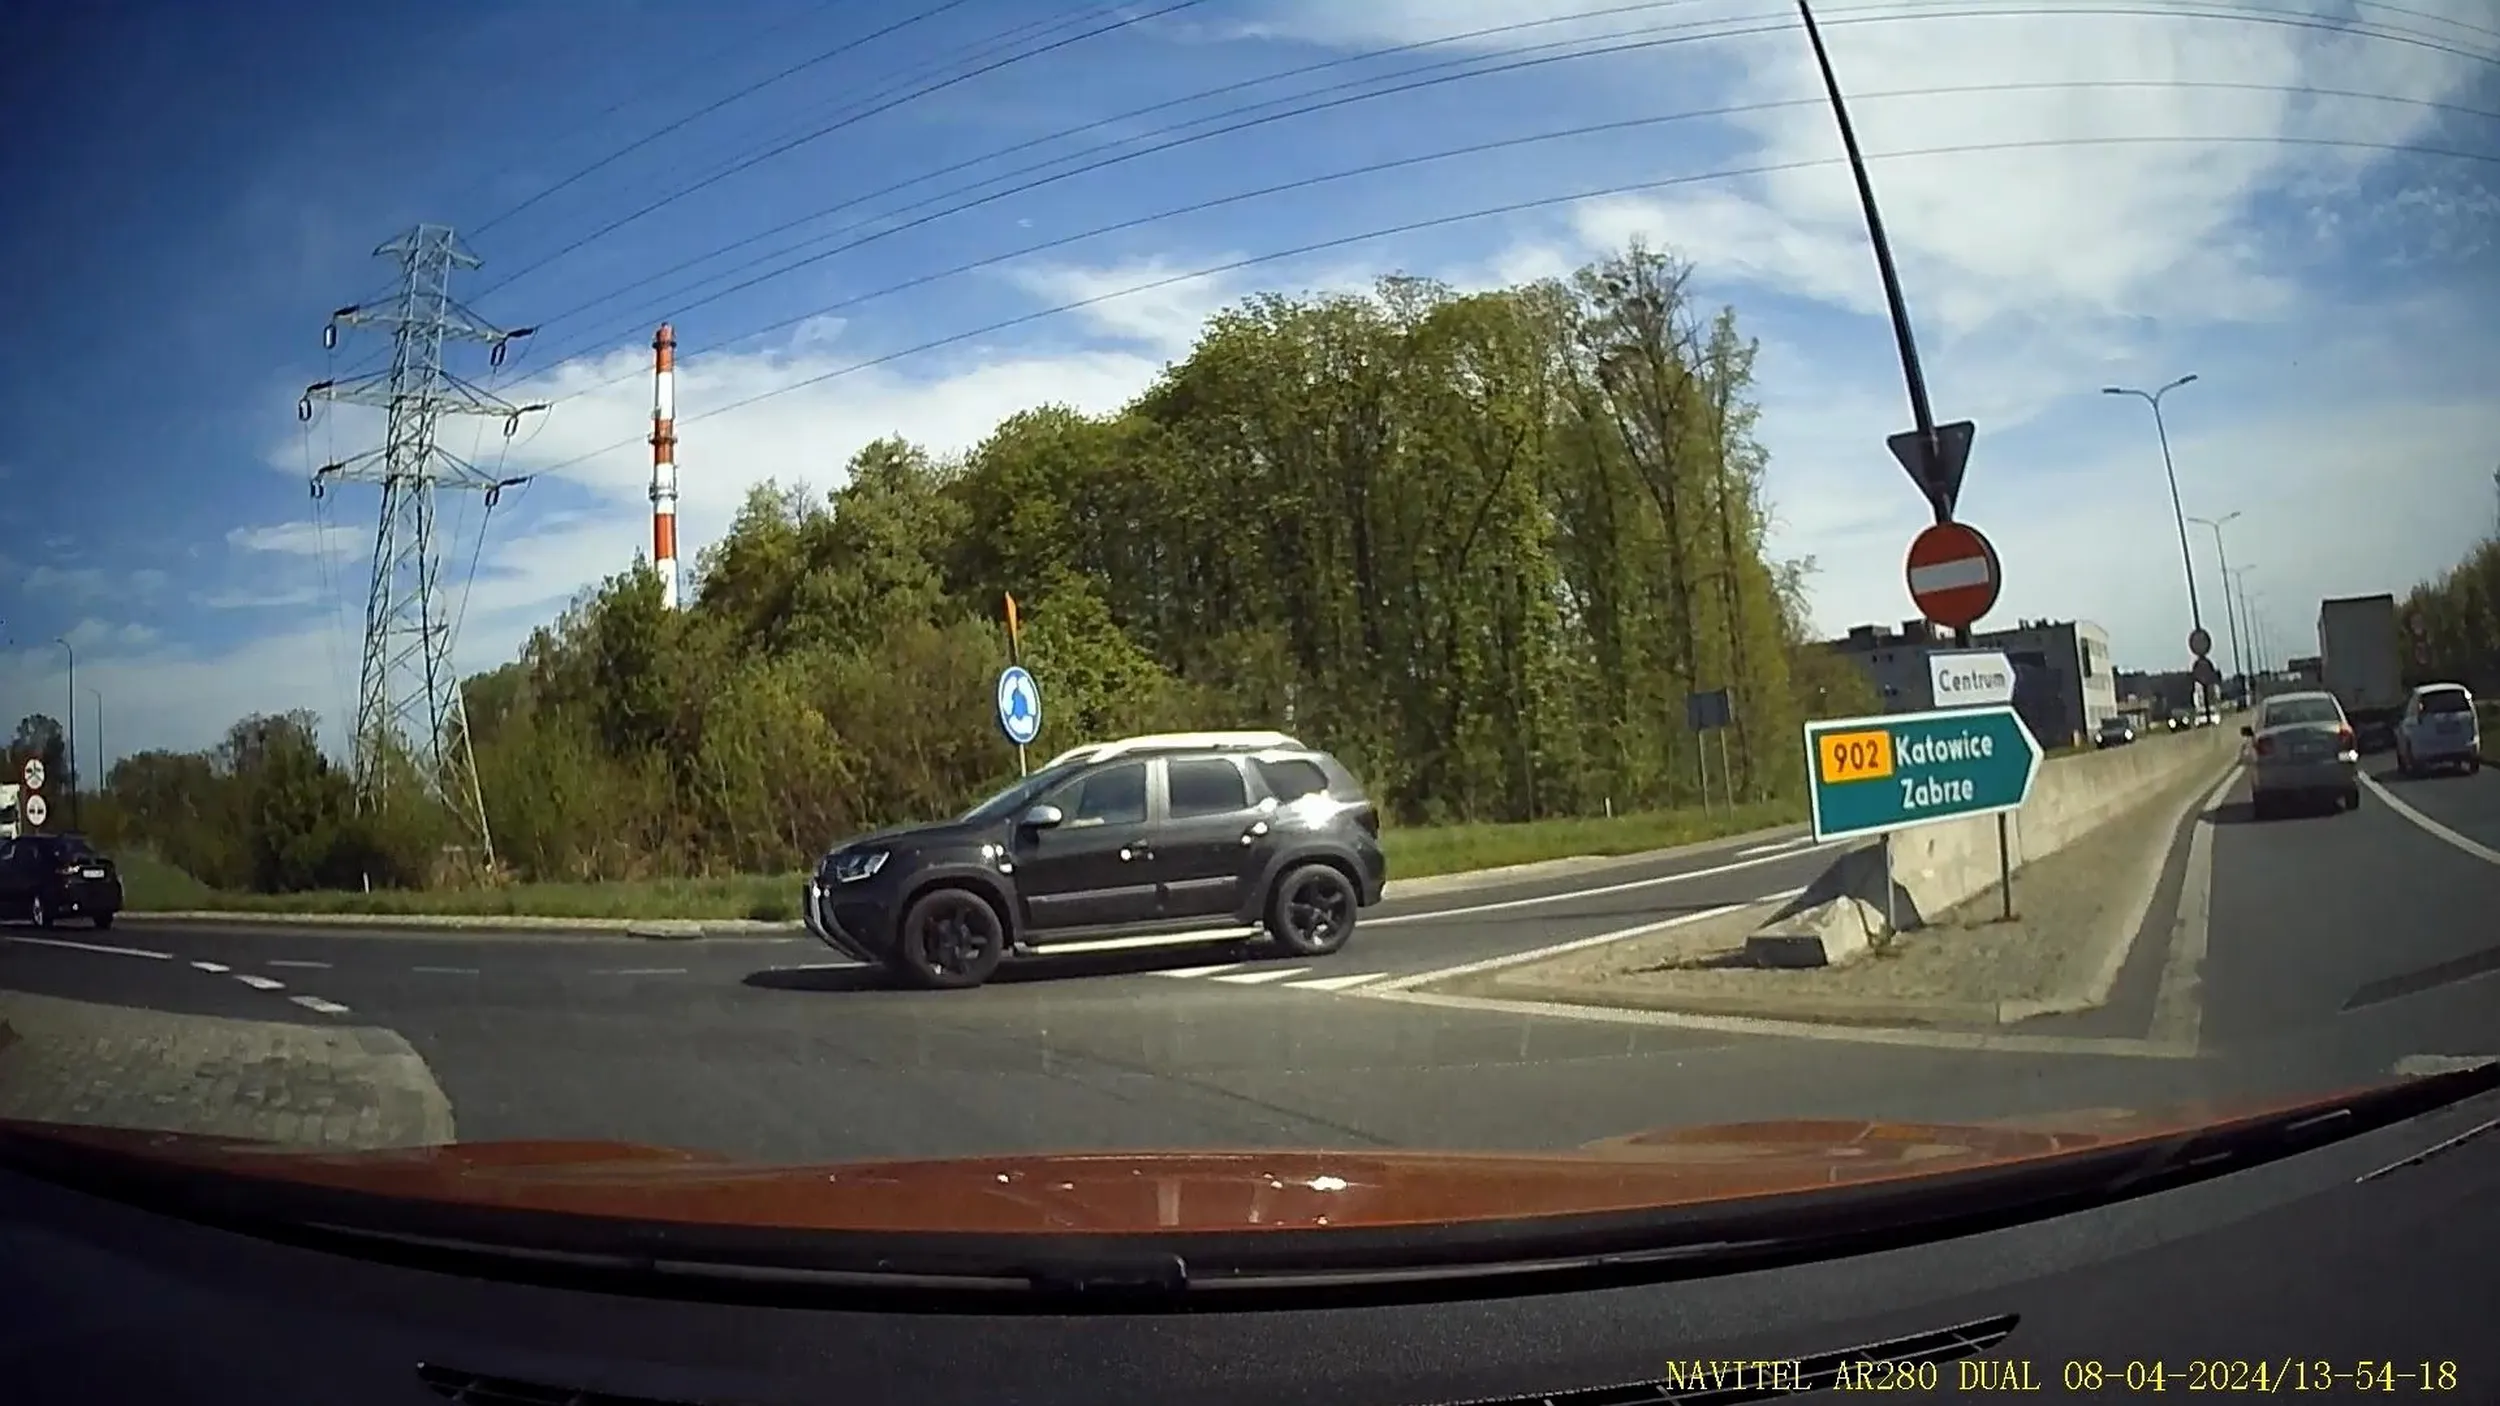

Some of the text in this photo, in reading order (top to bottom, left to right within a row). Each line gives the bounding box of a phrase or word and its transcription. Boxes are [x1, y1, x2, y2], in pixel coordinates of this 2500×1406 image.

[1938, 669, 2005, 692] Centrum
[1833, 729, 1993, 773] 902 Katowice
[1901, 775, 1973, 808] Zabrze
